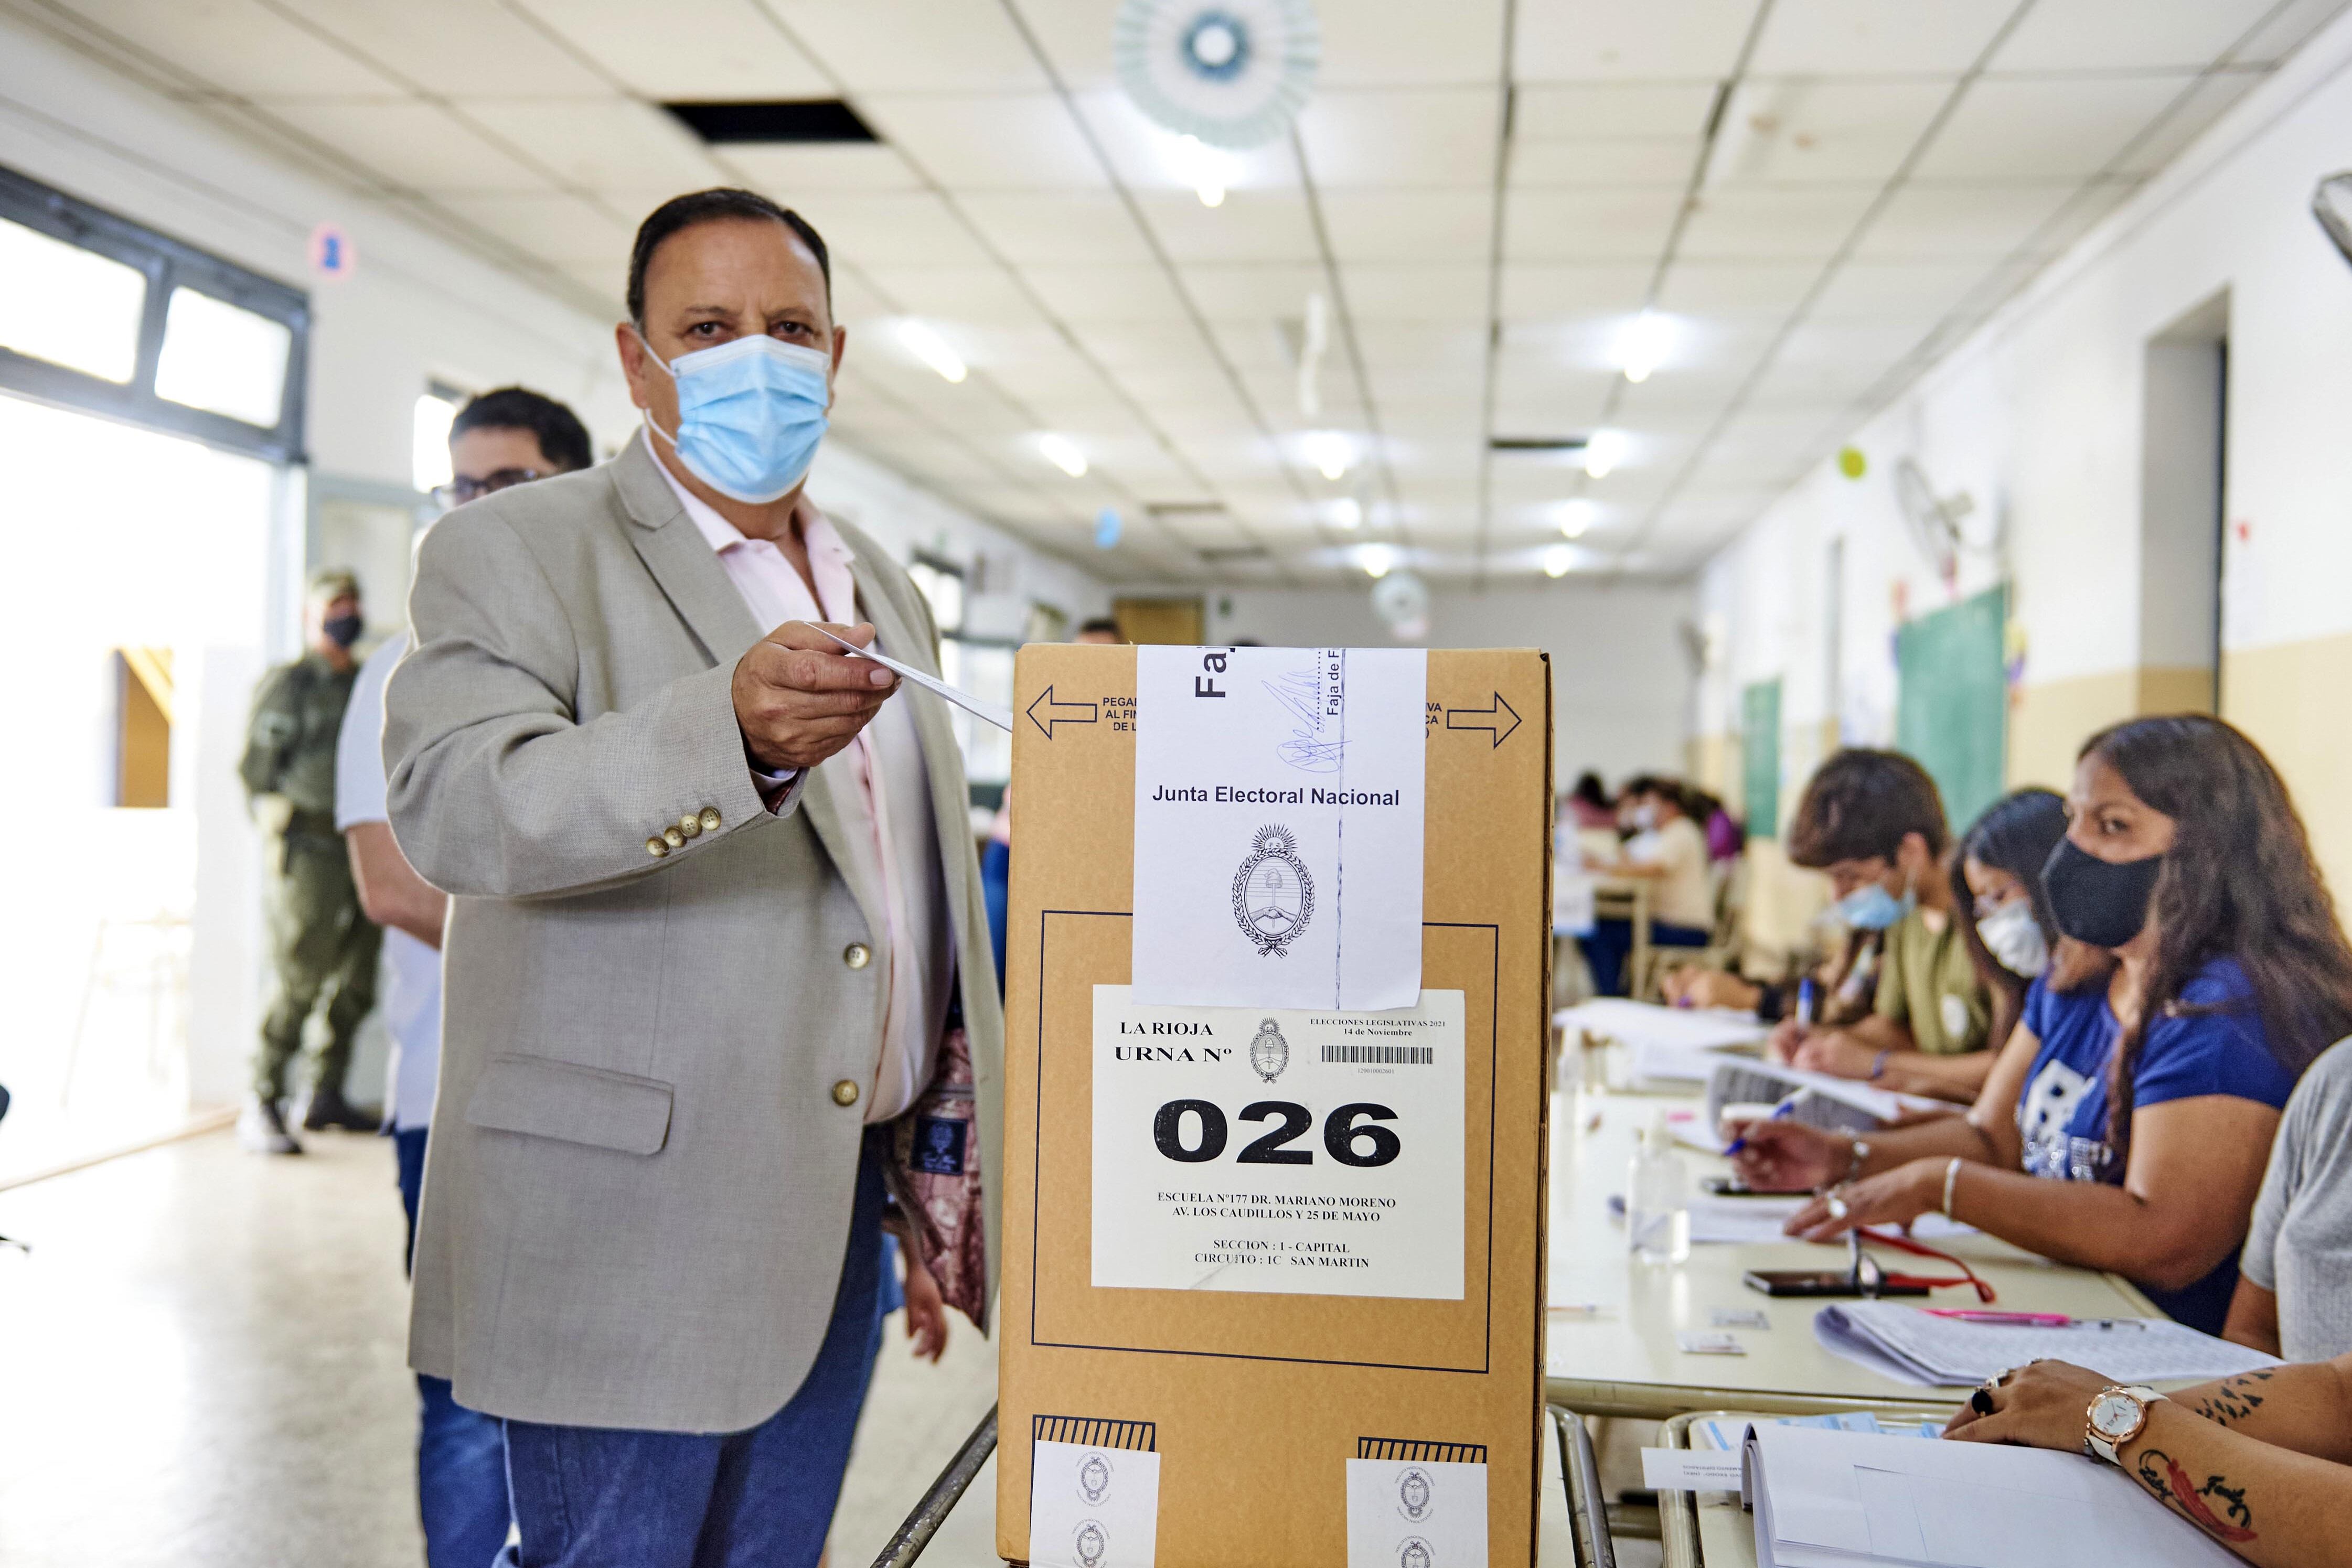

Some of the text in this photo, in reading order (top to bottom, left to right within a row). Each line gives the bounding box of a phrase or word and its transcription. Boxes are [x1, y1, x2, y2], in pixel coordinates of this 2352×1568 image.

[1195, 647, 1236, 698] Fa
[1327, 650, 1342, 715] Faja de F
[1105, 710, 1120, 718] AL
[1427, 702, 1442, 712] VA
[1113, 722, 1128, 731] DE
[1152, 785, 1399, 806] Junta Electoral Nacional
[1120, 1022, 1213, 1036] LA RIOJA
[1114, 1046, 1196, 1062] URNA
[1153, 1098, 1402, 1168] 026
[1158, 1192, 1214, 1202] ESCUELA
[1251, 1195, 1271, 1205] DR.
[1275, 1195, 1336, 1206] MARIANO
[1339, 1197, 1396, 1208] MORENO
[1172, 1207, 1381, 1222] AV. LOS CAUDILLOS Y 25 DE MAYO
[1213, 1239, 1268, 1250] SECCION
[1296, 1242, 1350, 1253] CAPITAL
[1194, 1252, 1256, 1264] CIRCUITO
[1267, 1255, 1281, 1265] 1C
[1290, 1256, 1315, 1266] SAN
[1319, 1257, 1369, 1268] MARTIN
